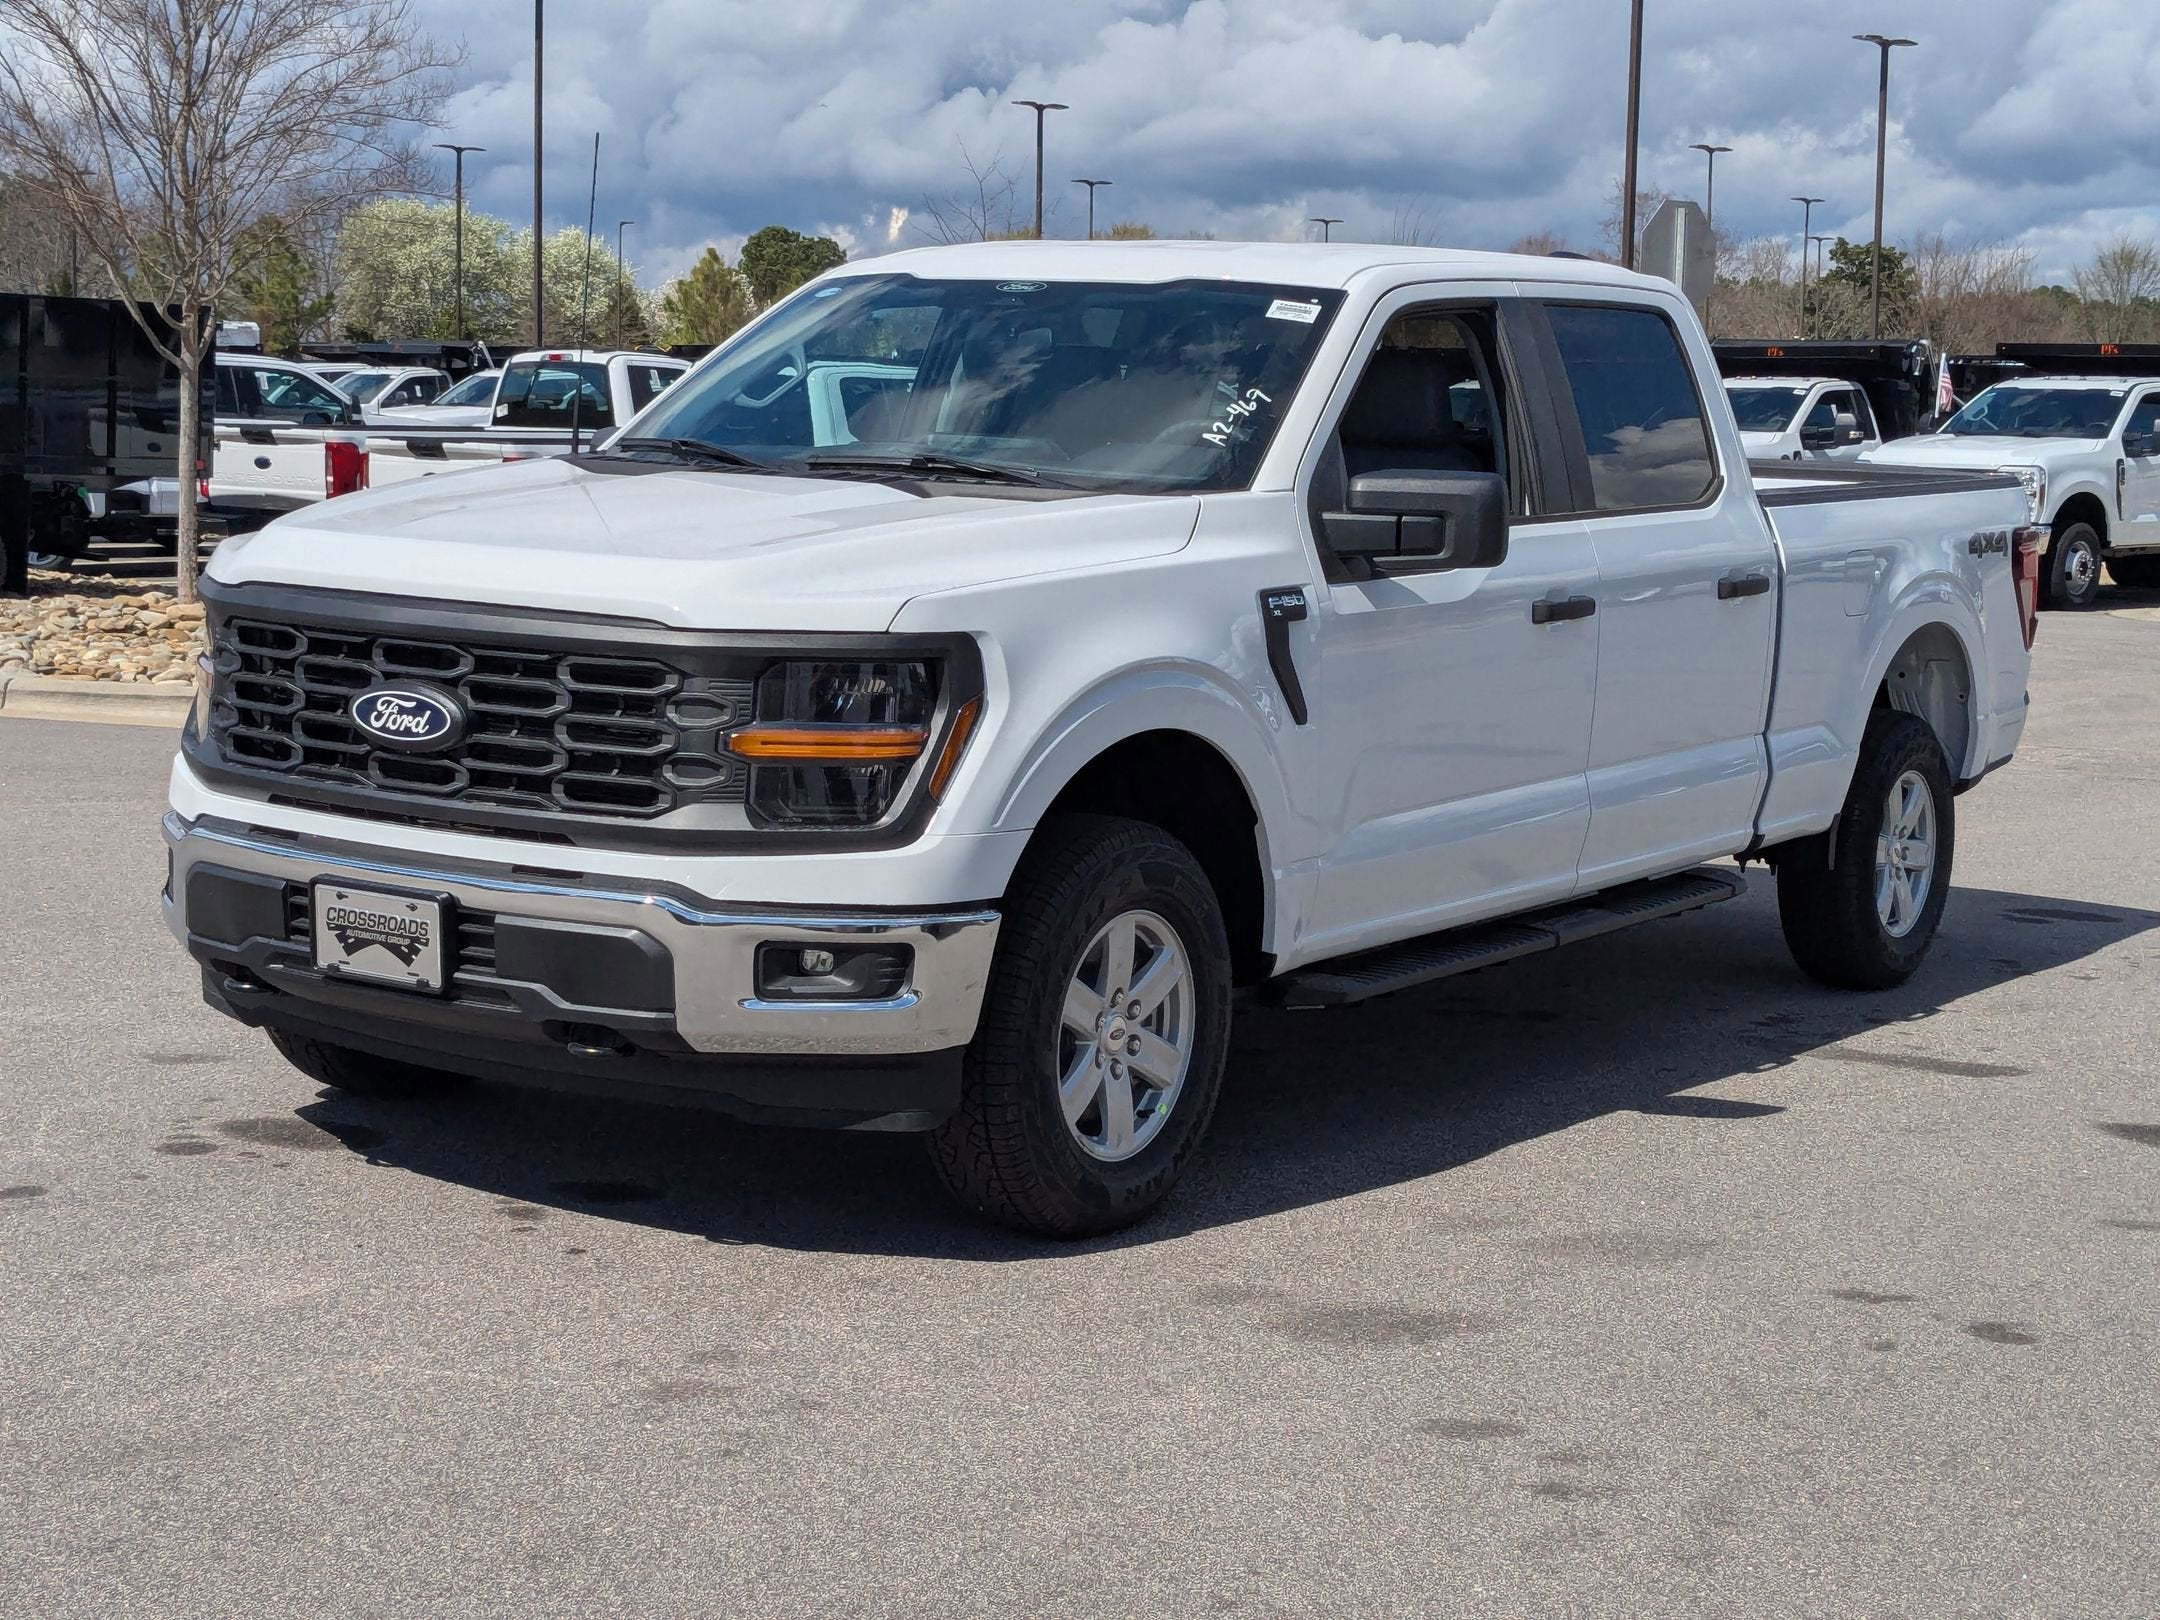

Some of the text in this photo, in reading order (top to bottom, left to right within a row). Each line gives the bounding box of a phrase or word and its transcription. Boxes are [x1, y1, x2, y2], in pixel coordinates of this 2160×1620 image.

[1202, 388, 1272, 447] A2-469
[370, 696, 431, 734] Ford
[326, 907, 430, 937] CROSSROADS
[345, 928, 411, 946] AUTOMOTIVE GROUP
